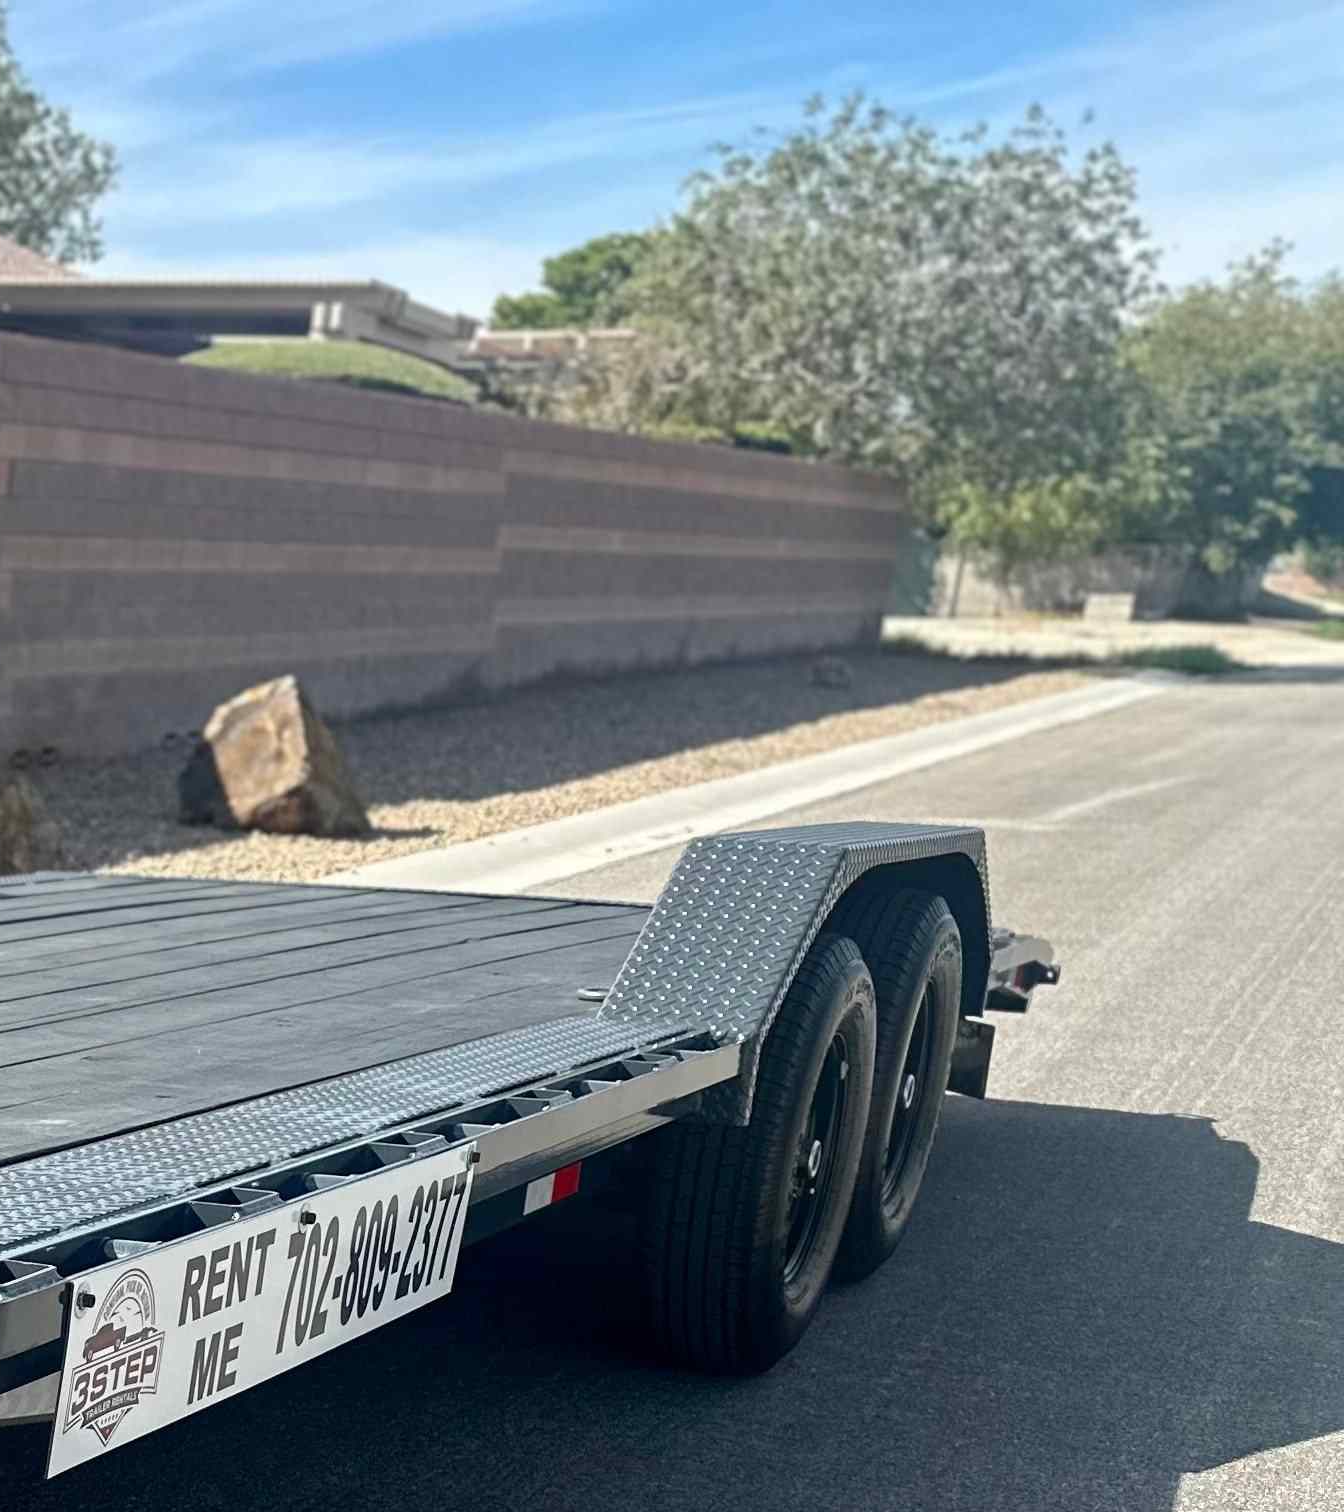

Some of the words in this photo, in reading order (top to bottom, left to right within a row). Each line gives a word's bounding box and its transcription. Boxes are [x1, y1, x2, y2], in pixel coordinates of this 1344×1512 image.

[178, 1228, 277, 1327] RENT
[276, 1171, 468, 1355] 702-809-2377
[71, 1345, 158, 1416] 3STEP
[187, 1322, 243, 1405] ME
